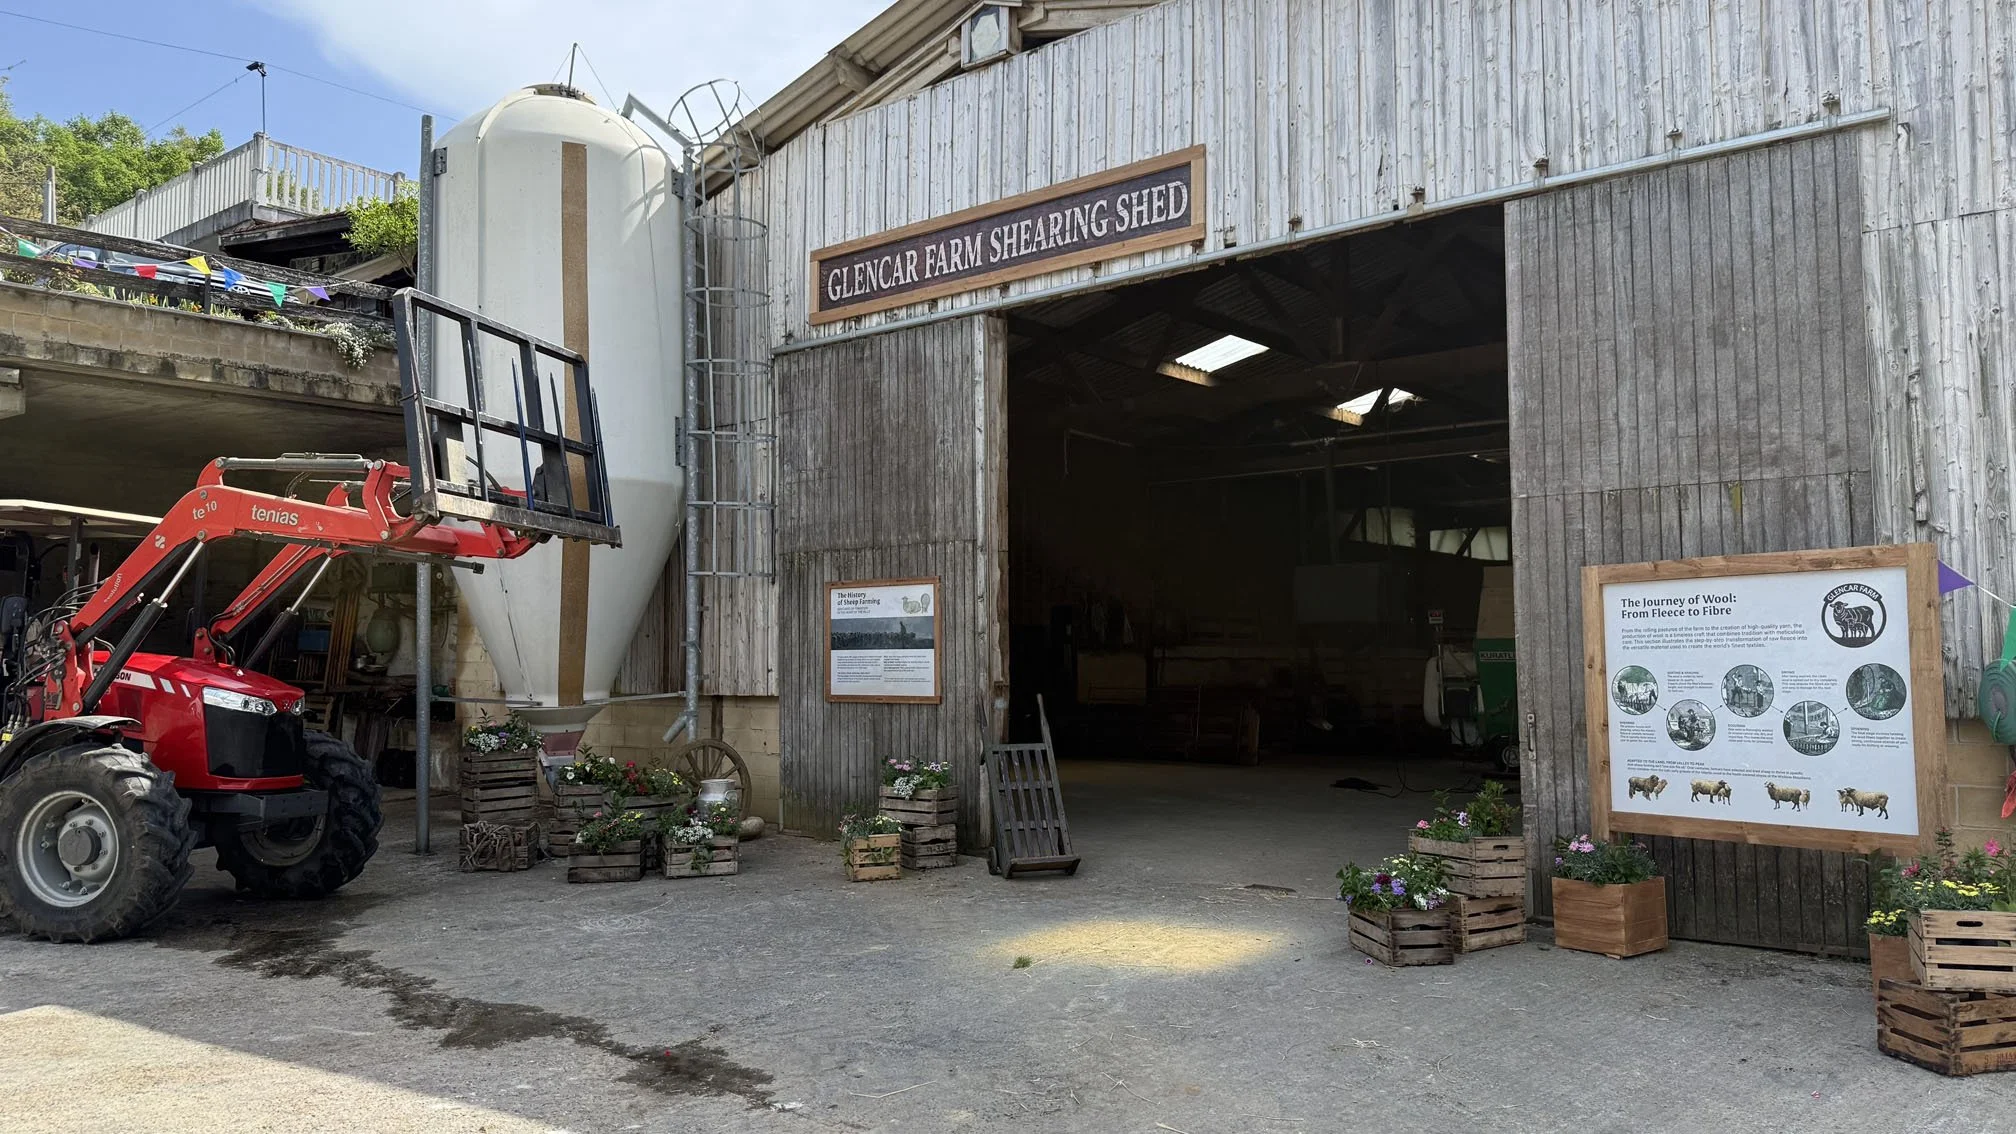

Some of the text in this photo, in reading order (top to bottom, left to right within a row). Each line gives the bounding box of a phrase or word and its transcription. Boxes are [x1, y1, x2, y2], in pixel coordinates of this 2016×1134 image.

[827, 180, 1188, 302] GLENCAR FARM SHEARING SHED
[1827, 584, 1879, 600] GLENCAR FARM
[1620, 593, 1736, 608] The Journey of Wool:
[1622, 606, 1732, 619] From Fleece to Fibre
